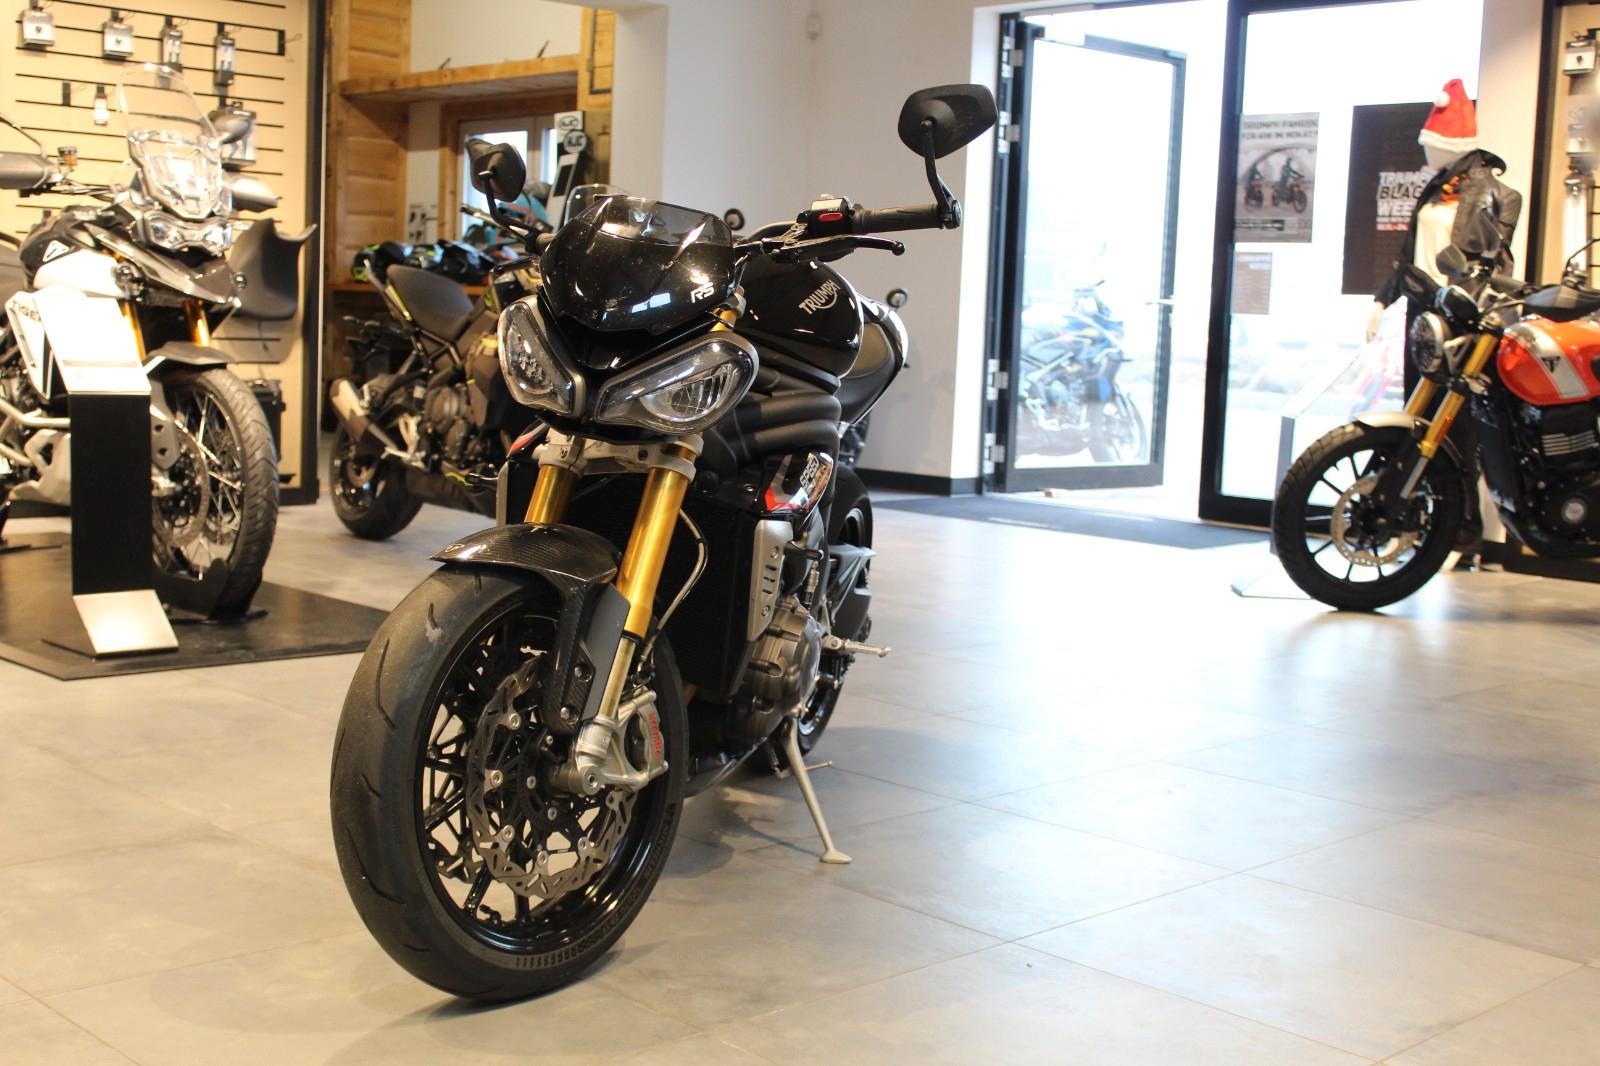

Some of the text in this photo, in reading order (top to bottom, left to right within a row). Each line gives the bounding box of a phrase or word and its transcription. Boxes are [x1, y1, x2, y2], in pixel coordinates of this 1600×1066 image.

[1379, 171, 1432, 187] TRIUMP
[1379, 185, 1422, 200] BLAC
[1377, 200, 1414, 217] WEE
[690, 281, 714, 303] RS
[798, 279, 841, 315] TRIUMPH
